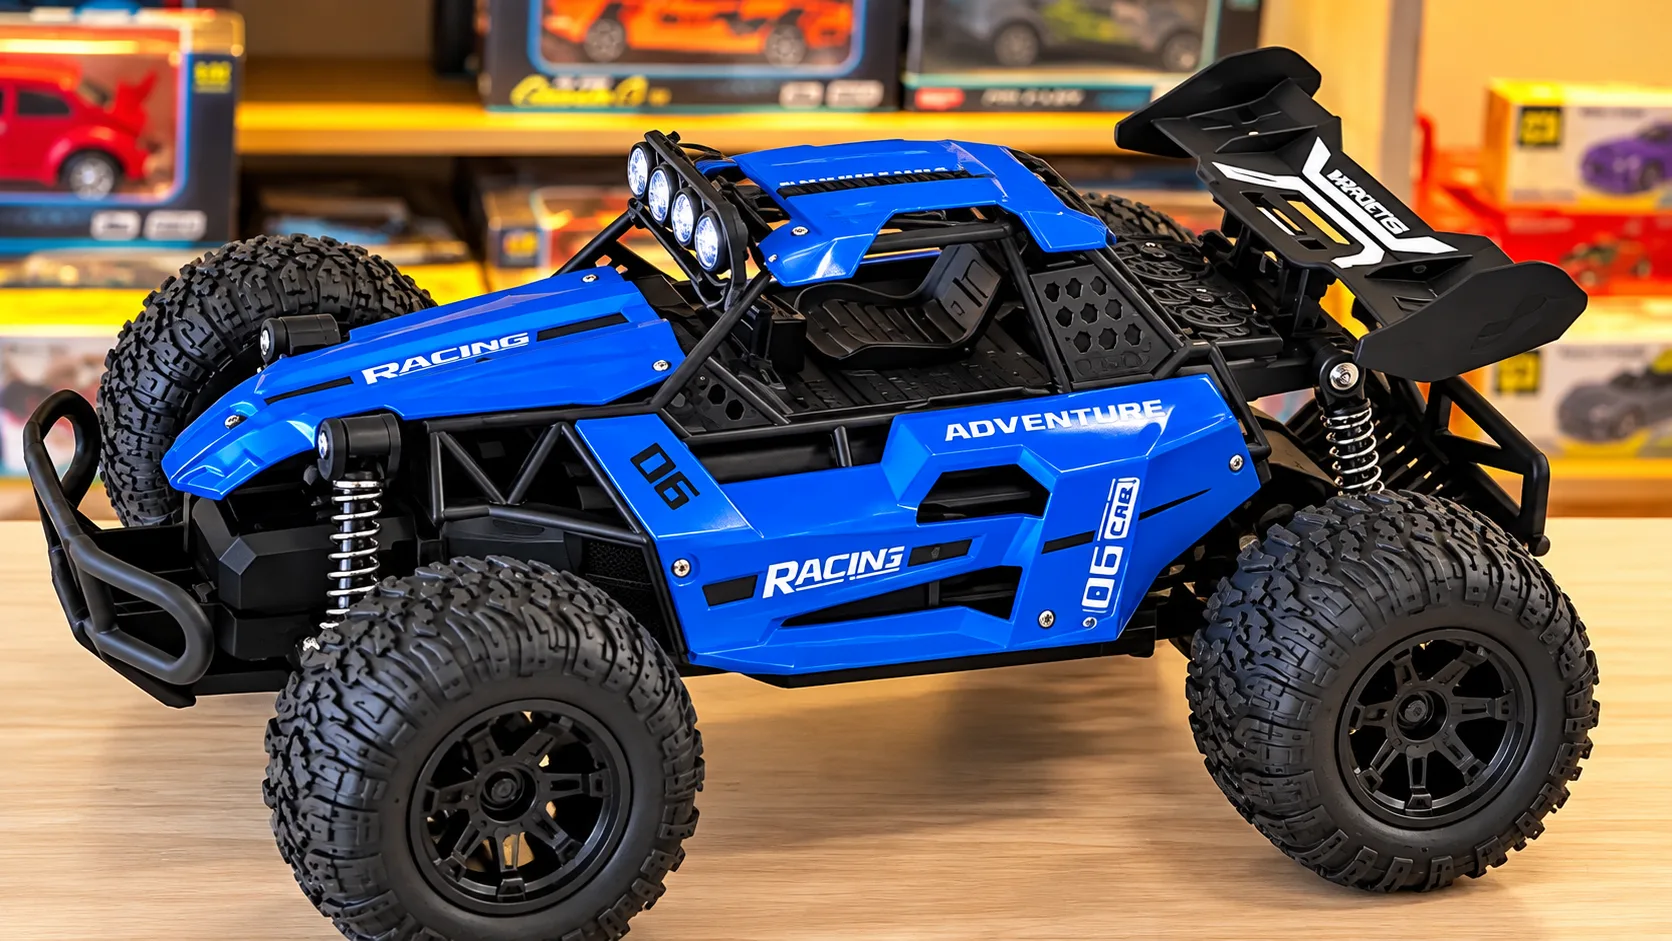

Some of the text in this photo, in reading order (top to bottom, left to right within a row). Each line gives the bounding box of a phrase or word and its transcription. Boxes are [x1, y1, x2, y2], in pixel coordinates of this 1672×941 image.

[361, 332, 530, 385] RACING
[944, 398, 1168, 442] ADVENTURE
[629, 441, 701, 511] 06
[762, 545, 906, 599] RACING
[1081, 545, 1124, 609] 06
